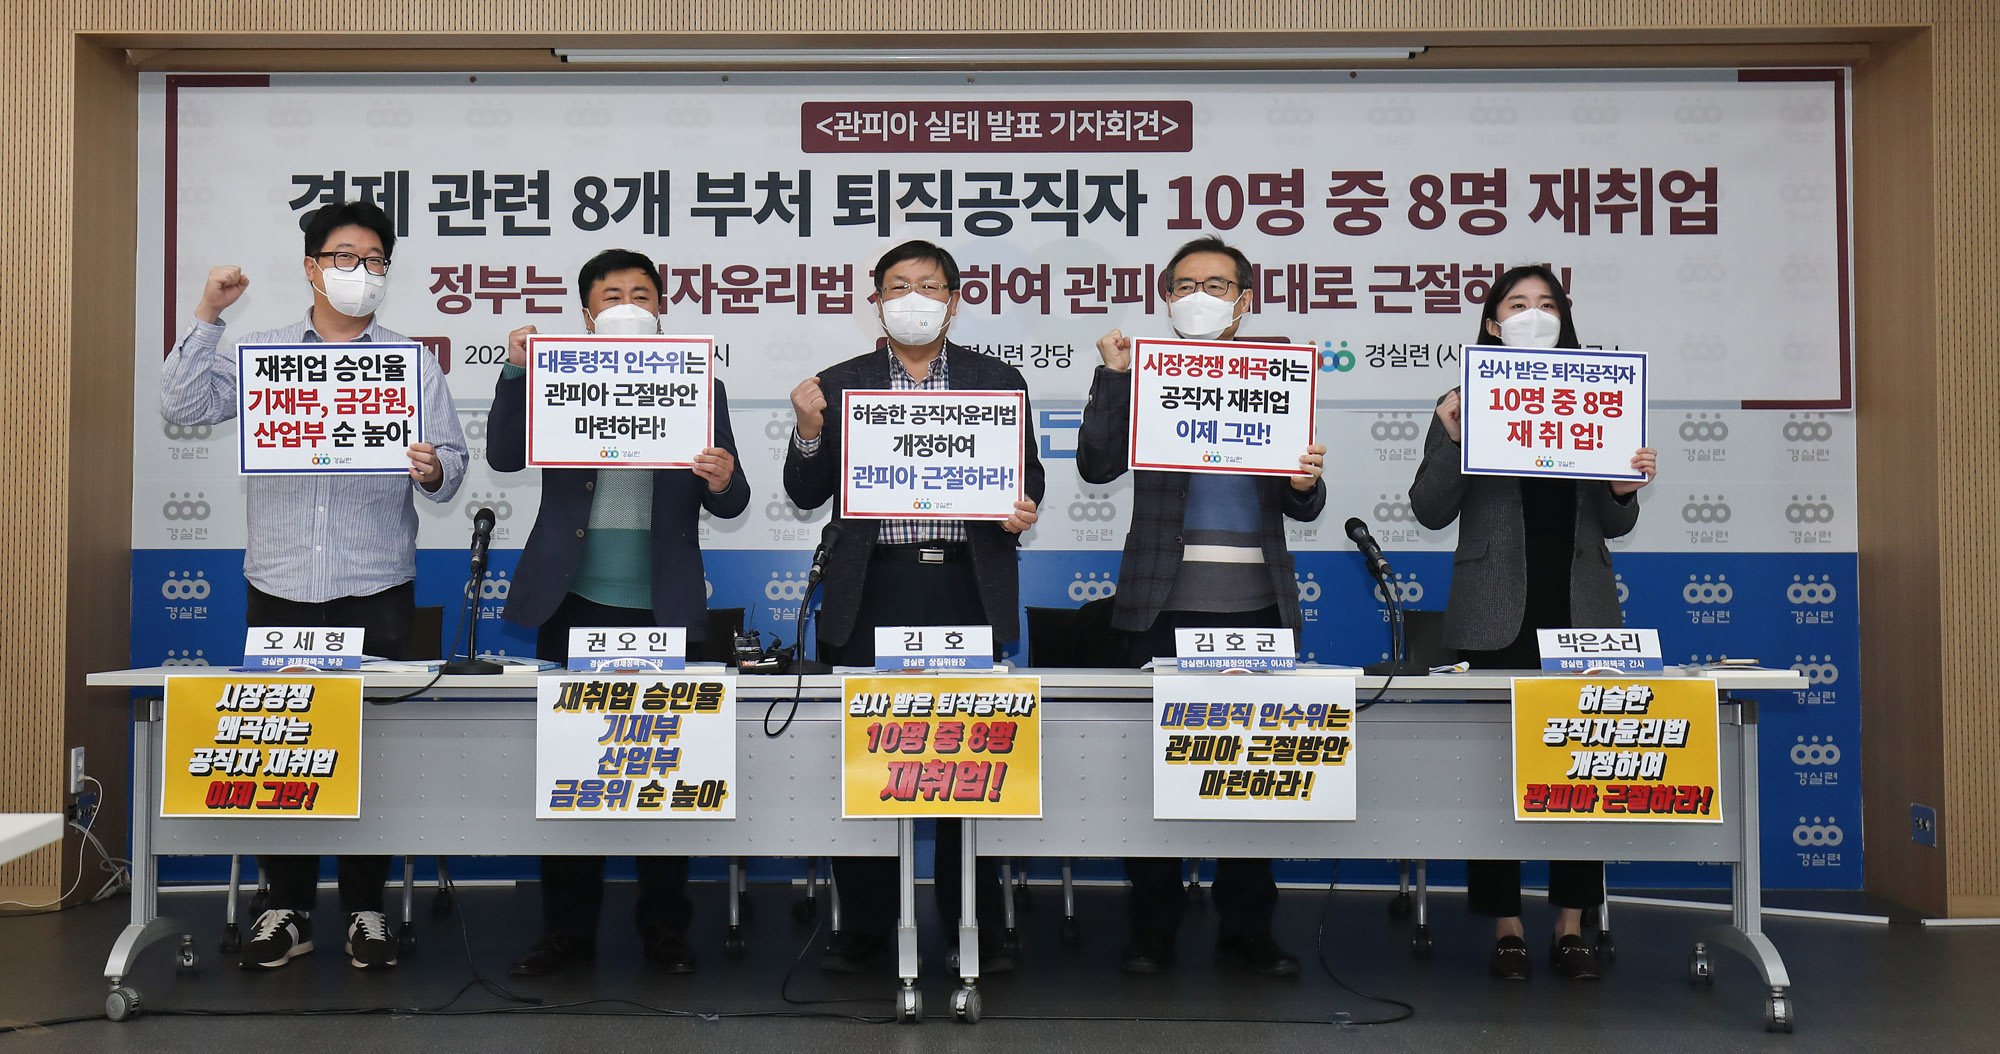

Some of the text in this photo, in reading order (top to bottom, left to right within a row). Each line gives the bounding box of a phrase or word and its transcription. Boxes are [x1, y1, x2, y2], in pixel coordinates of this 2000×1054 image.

[816, 109, 1179, 142] <관피아 실태 발표 기자회견>
[428, 170, 551, 236] 관련
[572, 170, 670, 237] 8개
[690, 170, 811, 237] 부처
[833, 169, 1147, 237] 퇴직공직자
[1167, 169, 1305, 236] 10명
[1326, 170, 1389, 235] 중
[1408, 168, 1507, 236] 8명
[1529, 167, 1718, 235] 재취업
[429, 264, 567, 314] 정부는
[658, 264, 853, 315] 자윤리법
[1251, 263, 1357, 314] 대로
[255, 354, 327, 382] 재취업
[334, 354, 406, 382] 승인율
[538, 350, 706, 374] 대통령직 인수위는
[1031, 344, 1074, 368] 강당
[1143, 352, 1310, 382] 시장경쟁 왜곡하는
[1365, 344, 1429, 368] 경실련
[1478, 359, 1636, 384] 심사 받은 퇴직공직자
[248, 387, 415, 418] 기재부, 금감원,
[544, 382, 698, 407] 관피아 근절방안
[1160, 386, 1290, 414] 공직자 재취업
[1489, 387, 1623, 418] 10명 중 8명
[852, 404, 1016, 426] 허술한 공직자윤리법
[254, 420, 411, 448] 산업부 순 높아
[575, 416, 666, 440] 마련하라!
[1176, 419, 1271, 446] 이제 그만!
[167, 447, 209, 460] 경실련
[892, 434, 975, 458] 개정하여
[1374, 448, 1416, 461] 경실련
[1682, 449, 1725, 462] 경실련
[1787, 449, 1830, 462] 경실련
[852, 465, 1014, 490] 관피아 근절하라!
[166, 528, 208, 541] 경실련
[1285, 529, 1317, 542] 실련
[1685, 531, 1728, 544] 경실련
[1789, 531, 1832, 544] 경실련
[165, 606, 207, 620] 경실련
[1687, 610, 1730, 624] 경실련
[1791, 611, 1834, 625] 경실련
[904, 631, 964, 651] 김 호
[1557, 633, 1641, 653] 박은소리
[262, 658, 343, 666] 경실련 경제정책국 부장
[902, 658, 925, 667] 경실련
[1270, 659, 1293, 668] 이사장
[1560, 659, 1584, 668] 경실련
[1629, 659, 1645, 668] 간사
[216, 683, 315, 712] 시장경쟁
[553, 681, 726, 713] 재취업 승인율
[848, 692, 1036, 717] 심사 받은 퇴직공직자
[1577, 684, 1654, 715] 허술한
[1792, 691, 1836, 704] 경실련
[1160, 702, 1353, 731] 대통령직 인수위는
[214, 715, 312, 744] 왜곡하는
[598, 714, 683, 746] 기재부
[867, 721, 1018, 754] 10명 중 8명
[1542, 717, 1690, 748] 공직자윤리법
[188, 747, 339, 777] 공직자 재취업
[1165, 735, 1352, 765] 관피아 근절방안
[597, 747, 683, 779] 산업부
[1566, 750, 1667, 780] 개정하여
[879, 759, 1008, 802] 재취업!
[1199, 769, 1316, 801] 마련하라!
[1794, 772, 1838, 786] 경실련
[205, 781, 319, 810] 이제 그만!
[549, 779, 729, 812] 금융위 순 높아
[1523, 783, 1714, 815] 관피아 근절하라!
[1797, 853, 1841, 867] 경실련
